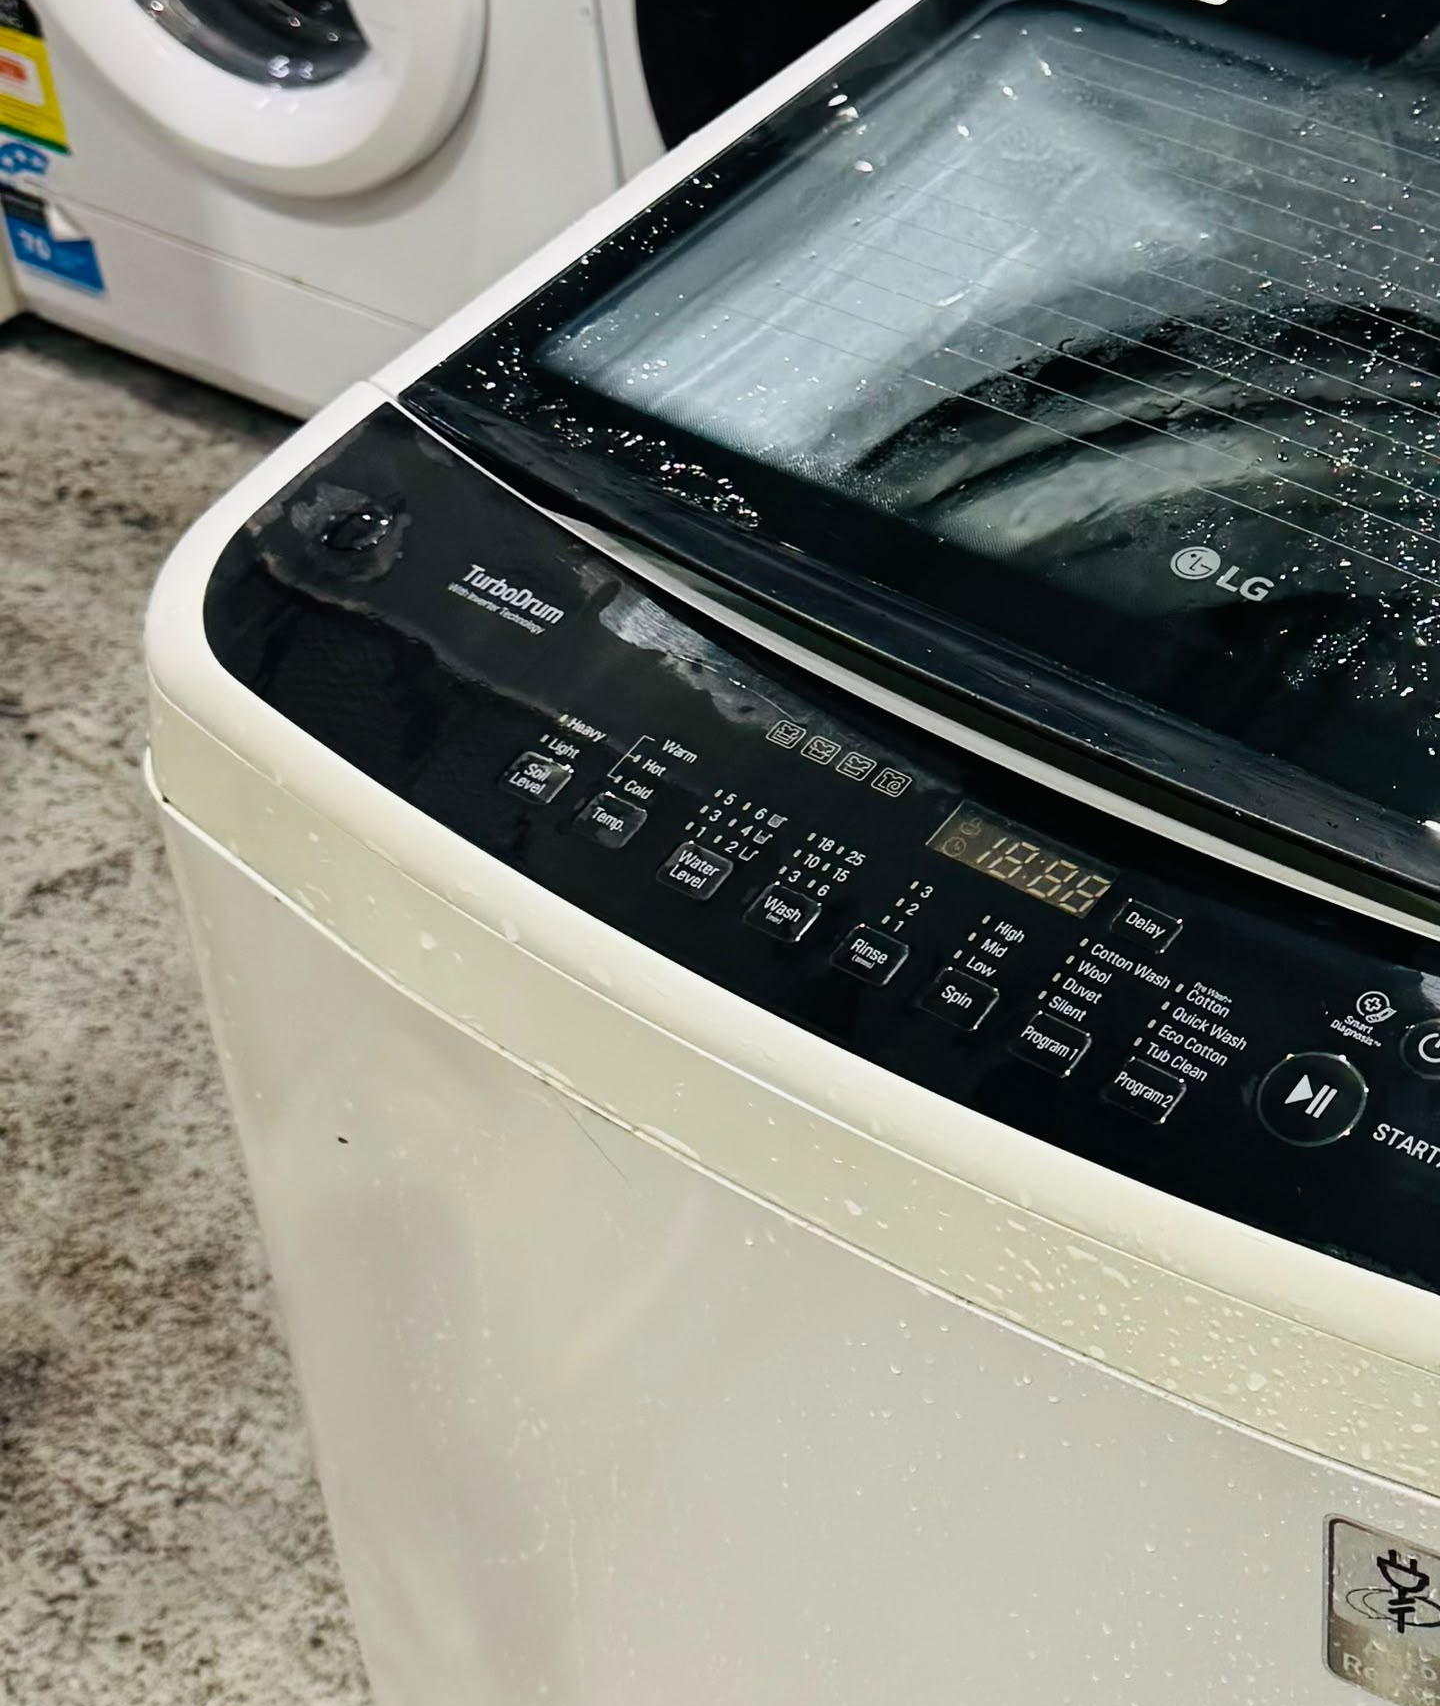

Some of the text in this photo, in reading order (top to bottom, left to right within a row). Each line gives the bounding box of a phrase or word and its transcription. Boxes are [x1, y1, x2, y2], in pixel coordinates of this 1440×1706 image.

[462, 563, 565, 624] TurboDrum
[1216, 565, 1275, 602] LG
[566, 717, 607, 742] Heavy
[548, 737, 580, 760] Light
[661, 739, 698, 764] Warm
[524, 762, 551, 782] Soil
[642, 759, 667, 777] Hot
[509, 772, 546, 795] Level
[623, 780, 654, 800] Cold
[592, 807, 624, 833] Temp.
[723, 793, 768, 821] 5 6
[708, 810, 754, 837] 3 4
[697, 826, 739, 854] 1 2
[817, 837, 866, 867] 18 25
[678, 849, 720, 877] Water
[803, 853, 850, 882] 10 15
[668, 864, 708, 890] Level
[788, 870, 830, 897] 3 6
[920, 885, 934, 898] 3
[764, 895, 802, 922] Wash
[905, 903, 920, 916] 2
[893, 921, 905, 933] 1
[994, 921, 1025, 944] High
[1125, 911, 1166, 940] Delay
[850, 938, 888, 964] Rinse
[980, 938, 1008, 958] Mid
[966, 956, 997, 978] Low
[1077, 960, 1113, 985] Wool
[1090, 943, 1171, 990] Cotton Wash
[940, 985, 973, 1009] Spin
[1062, 977, 1103, 1005] Duvet
[1186, 989, 1230, 1018] Cotton
[1048, 996, 1087, 1022] Silent
[1172, 1007, 1247, 1052] Quick Wash
[1344, 1015, 1374, 1034] Smart
[1020, 1025, 1079, 1062] Program 1
[1157, 1024, 1229, 1067] Eco Cotton
[1145, 1042, 1208, 1082] Tub Clean
[1114, 1070, 1165, 1106] Program
